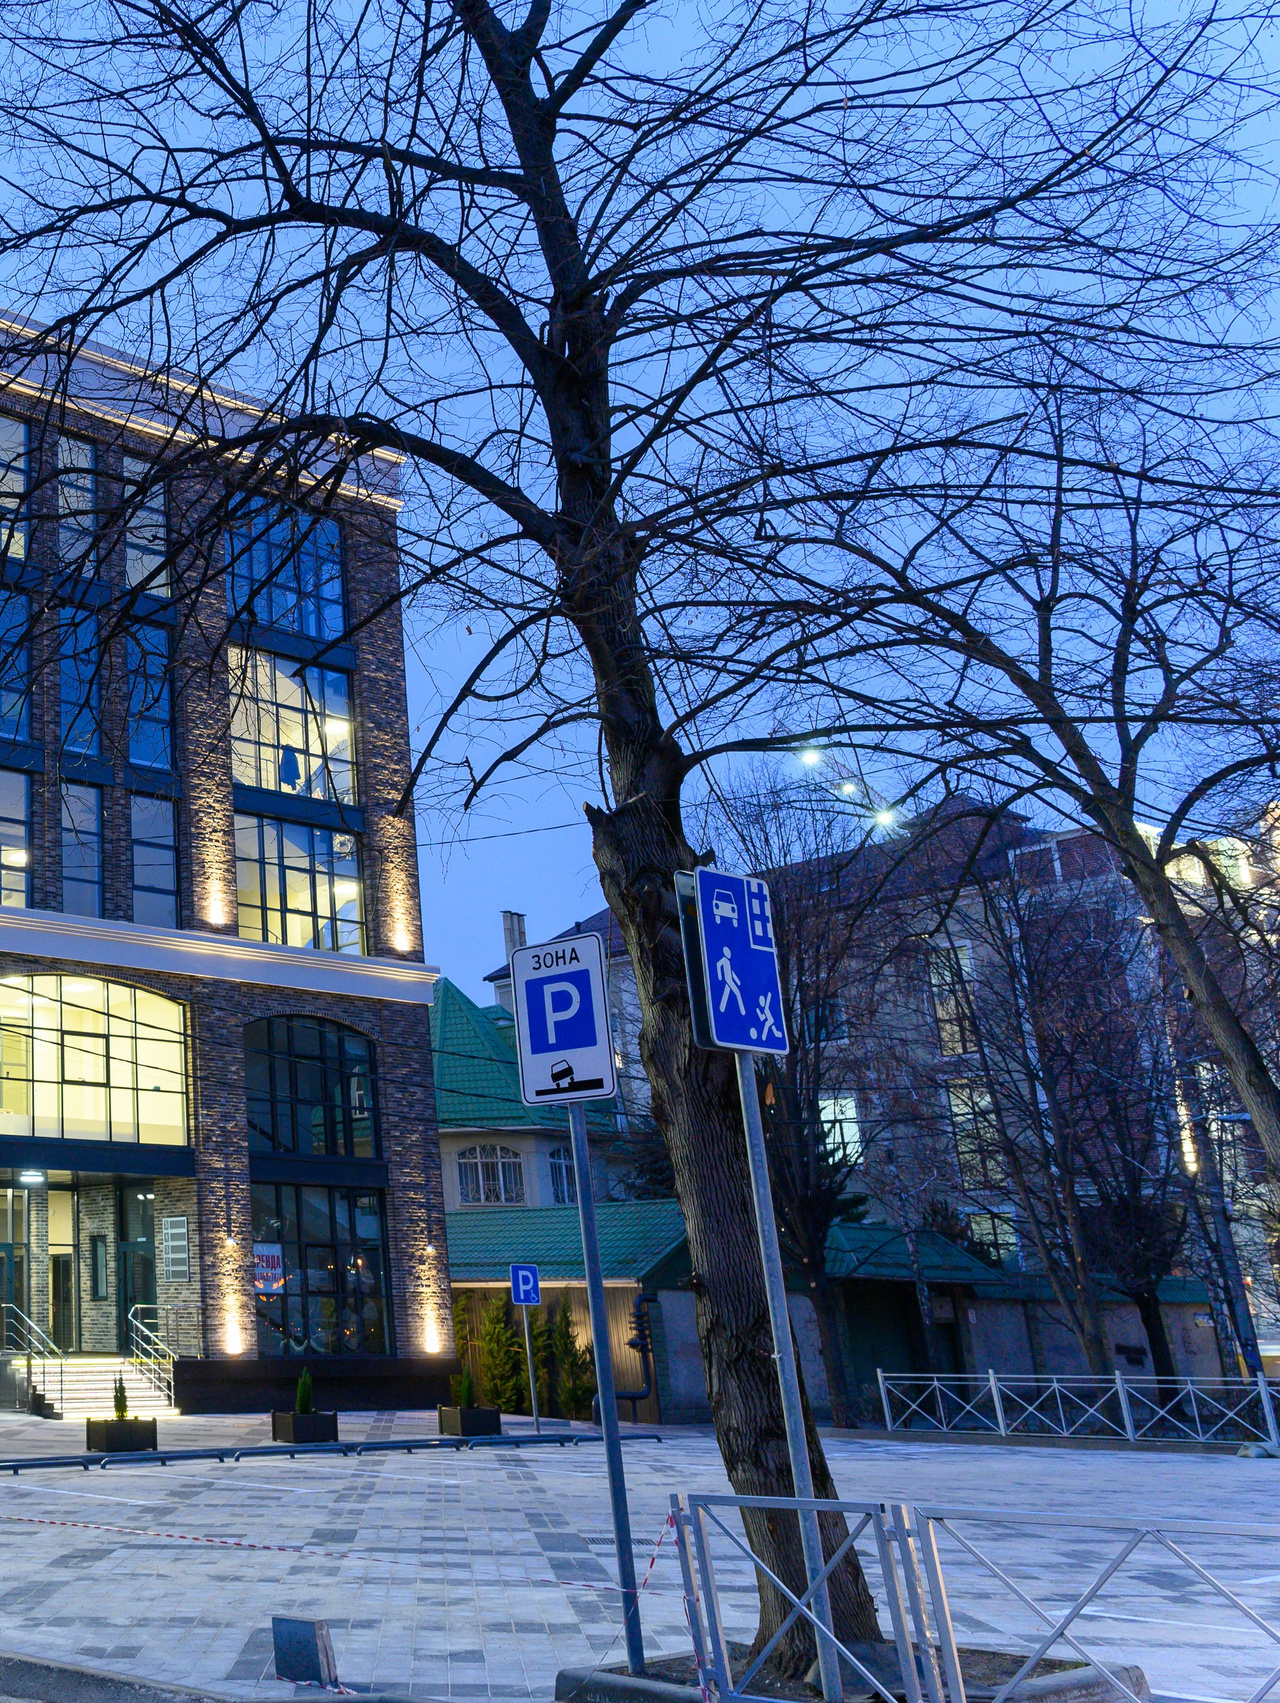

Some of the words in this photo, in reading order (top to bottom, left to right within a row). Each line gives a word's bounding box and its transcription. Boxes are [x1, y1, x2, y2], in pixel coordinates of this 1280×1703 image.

[531, 946, 580, 971] ЗОНА
[543, 981, 580, 1044] P
[518, 1270, 534, 1300] P
